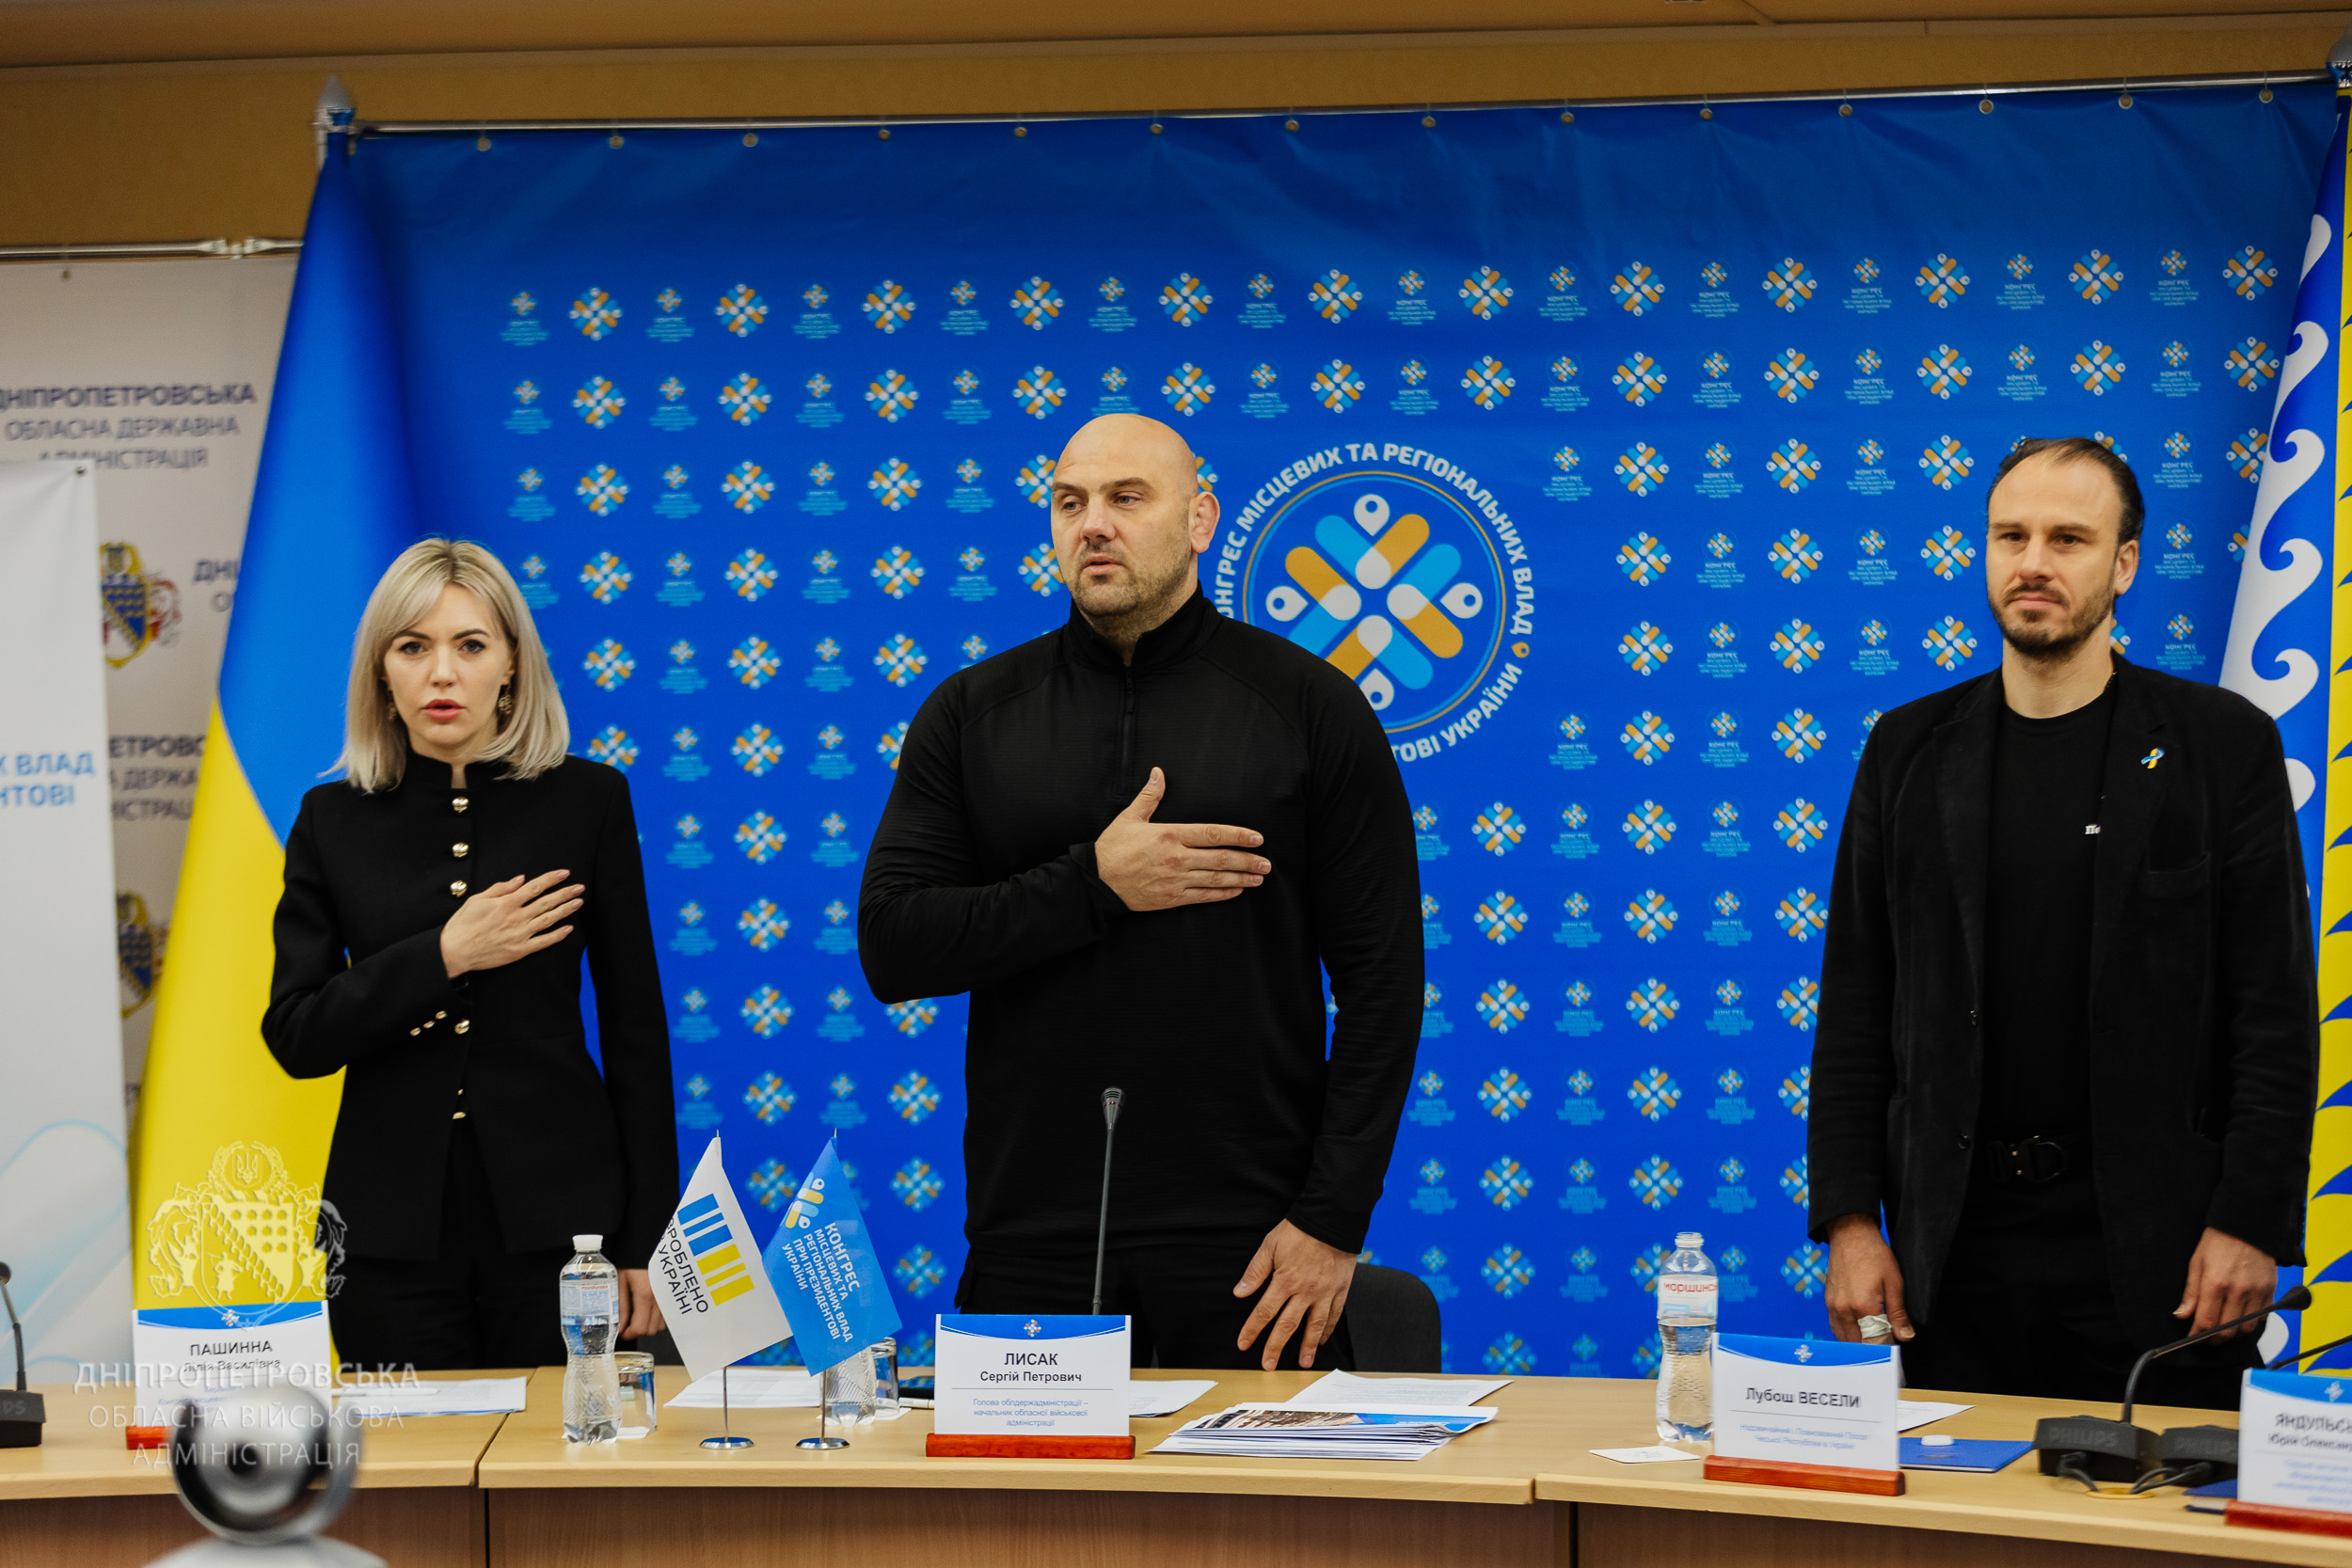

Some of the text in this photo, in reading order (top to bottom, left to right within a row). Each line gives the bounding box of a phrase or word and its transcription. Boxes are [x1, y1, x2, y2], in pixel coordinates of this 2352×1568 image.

[4, 417, 241, 440] ОБЛАСНА ДЕРЖАВНА
[1215, 442, 1534, 636] ОНГРЕС МІСЦЕВИХ ТА РЕГІОНАЛЬНИХ ВЛАД
[1439, 662, 1523, 747] УКРАЇНИ
[16, 752, 95, 776] ВЛАД
[659, 1244, 692, 1315] УКРАЇНІ
[782, 1243, 808, 1291] УКРАЇНИ
[814, 1228, 849, 1301] МІСЦЕВИХ ТА
[824, 1222, 861, 1292] КОНГРЕС
[792, 1238, 841, 1339] ПРИ ПРЕЗИДЕНТОВІ
[803, 1233, 853, 1343] РЕГІОНАЛЬНИХ ВЛАД
[190, 1340, 273, 1356] ПАШИННА
[1004, 1353, 1058, 1366] ЛИСАК
[980, 1370, 1082, 1384] Сергій Петрович
[1746, 1387, 1861, 1408] Лубош ВЕСЕЛИ
[1007, 1418, 1055, 1427] адміністрації
